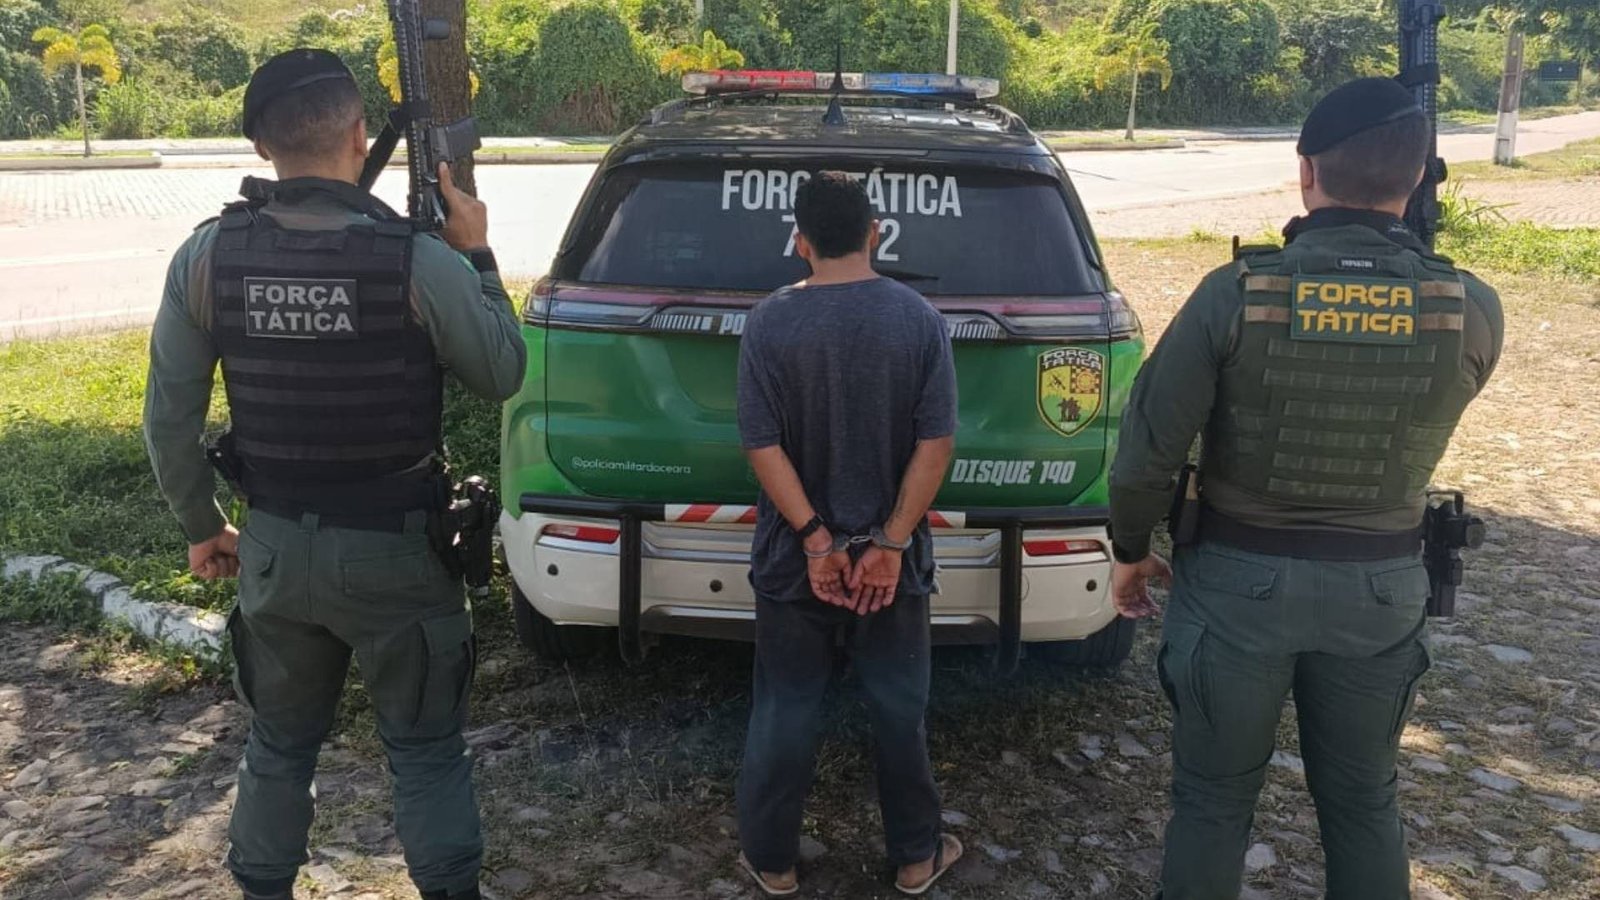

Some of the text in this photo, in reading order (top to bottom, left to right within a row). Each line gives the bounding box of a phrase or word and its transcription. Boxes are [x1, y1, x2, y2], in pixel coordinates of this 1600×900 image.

[248, 284, 351, 310] FORÇA
[1297, 281, 1413, 307] FORÇA
[248, 307, 354, 332] TÁTICA
[1297, 308, 1414, 336] TÁTICA
[950, 458, 1077, 486] DISQUE 190
